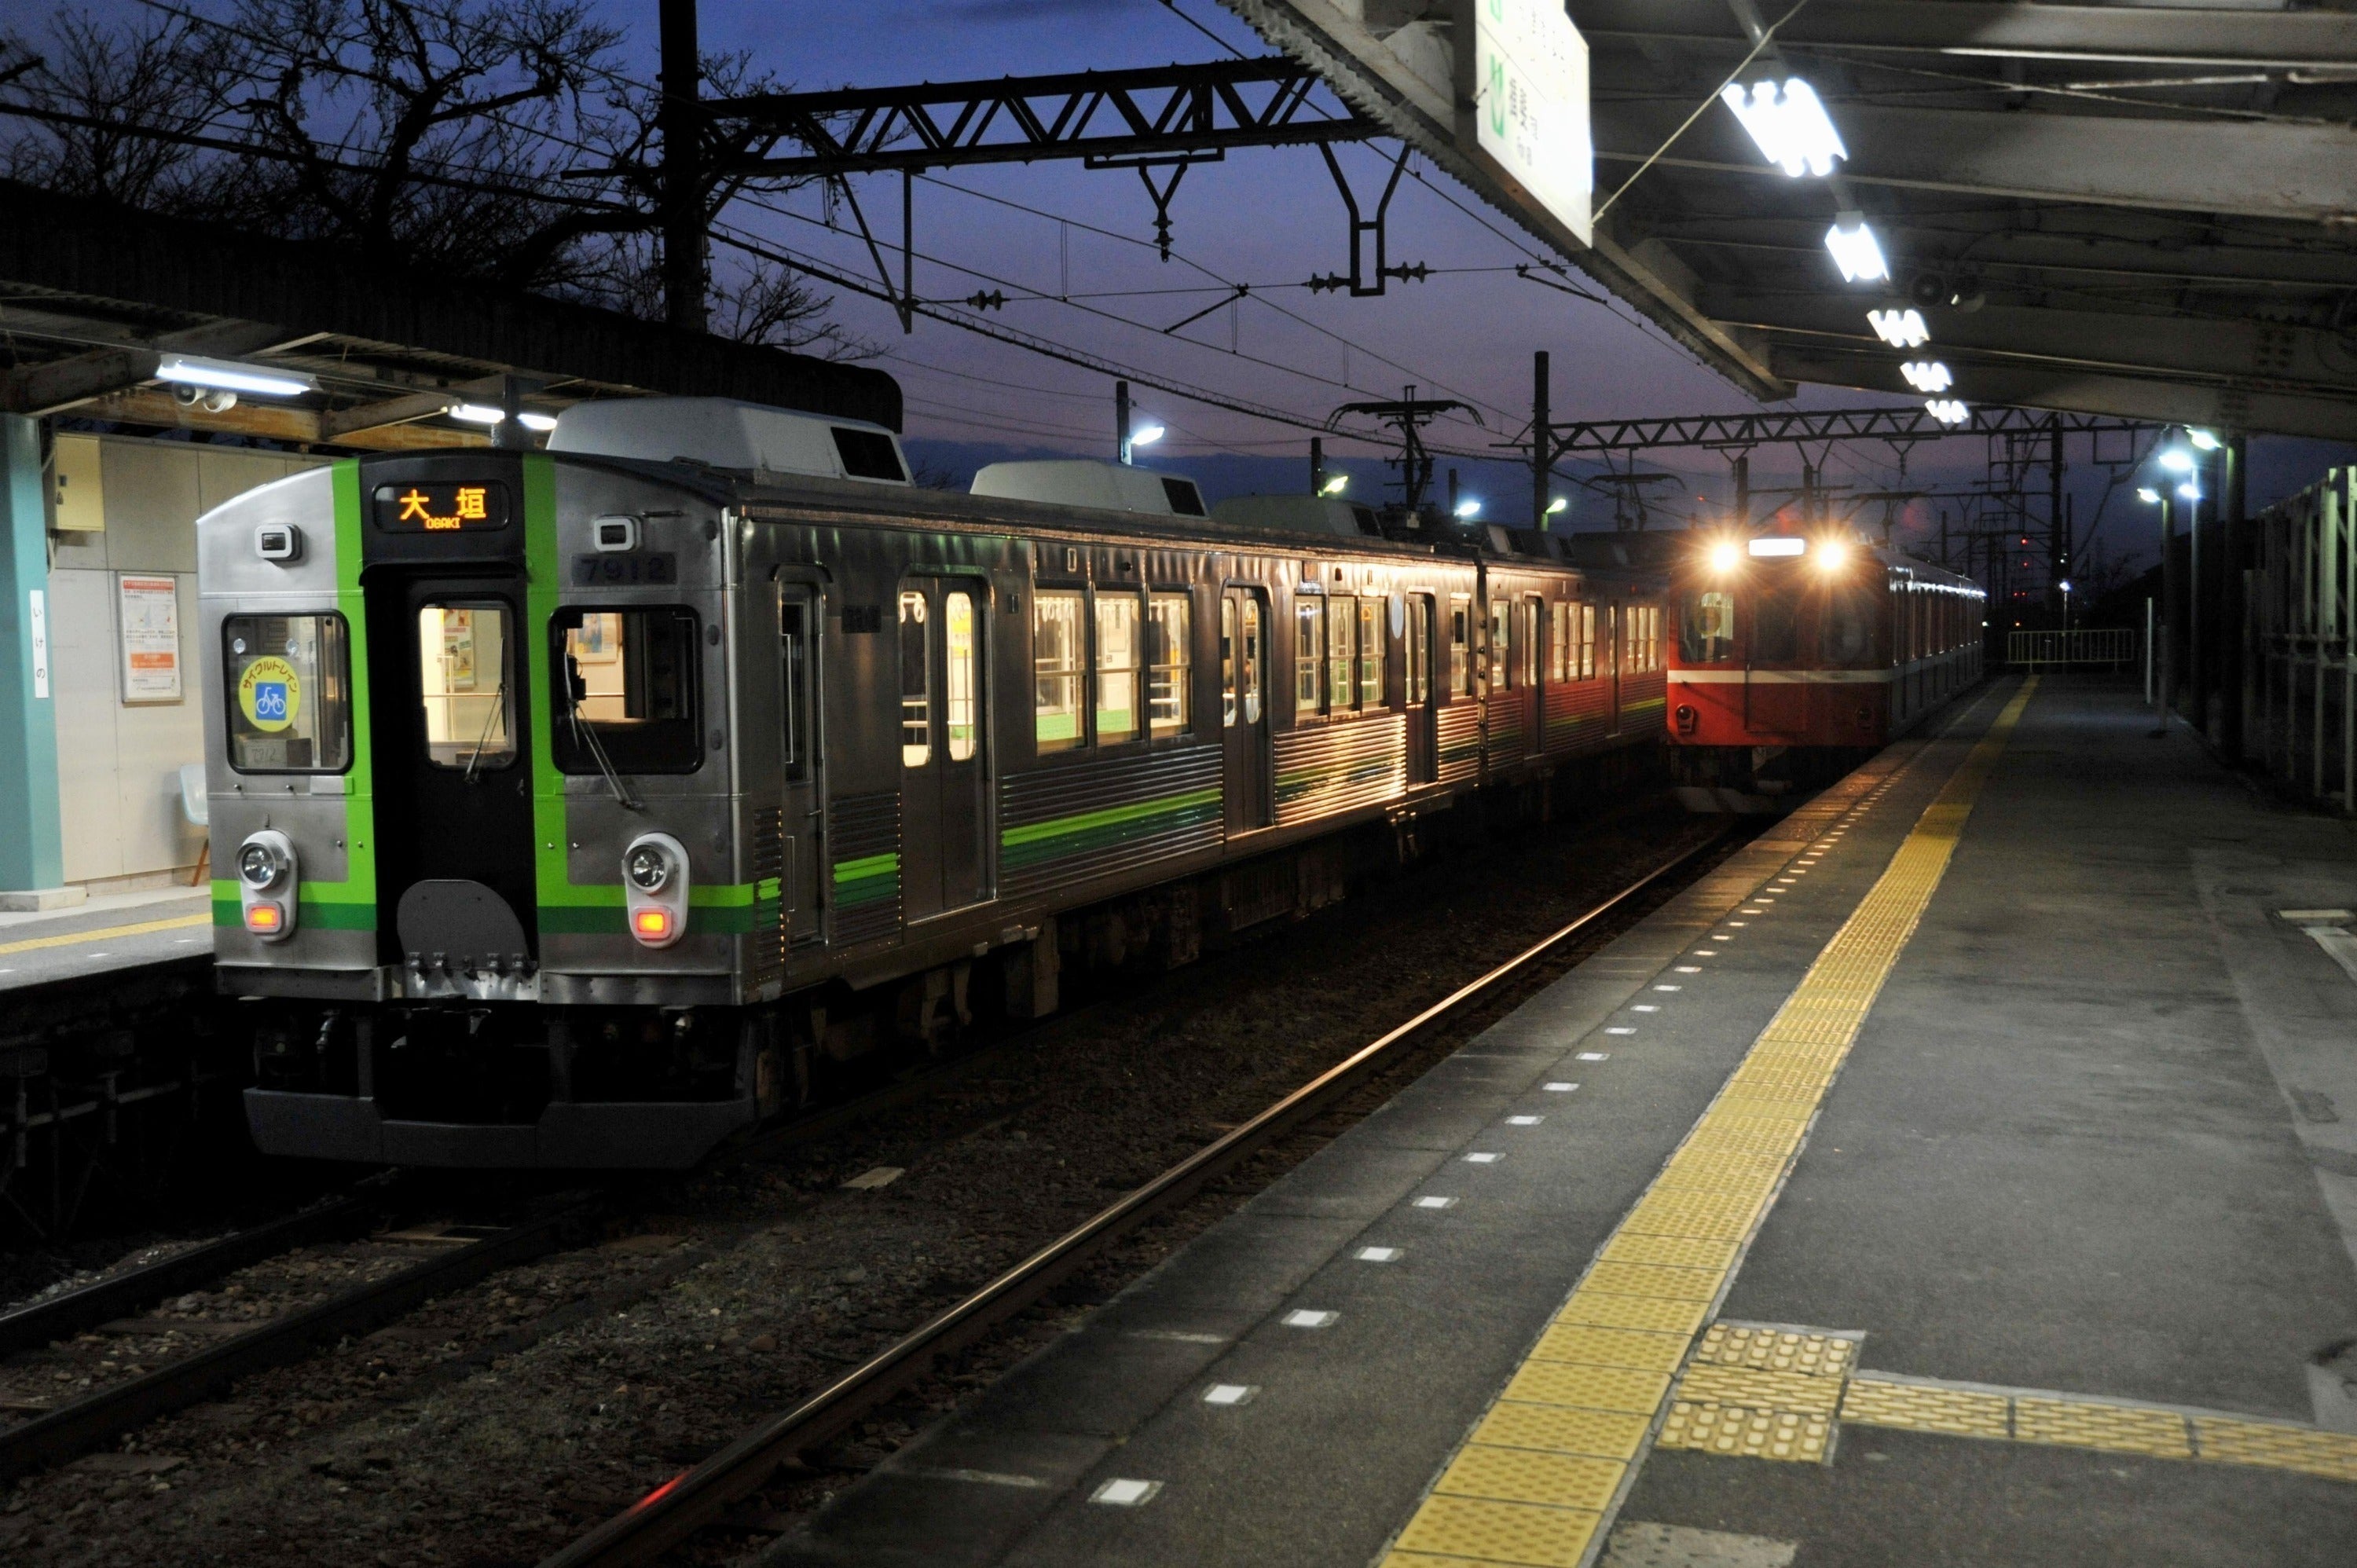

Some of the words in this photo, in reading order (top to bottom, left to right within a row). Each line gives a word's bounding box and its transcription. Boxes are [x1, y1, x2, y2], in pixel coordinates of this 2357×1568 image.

[400, 488, 486, 520] 大垣
[425, 517, 460, 529] OGAKI
[581, 556, 666, 581] 7912
[33, 606, 46, 679] いけの
[243, 661, 297, 692] サイクルトレイン
